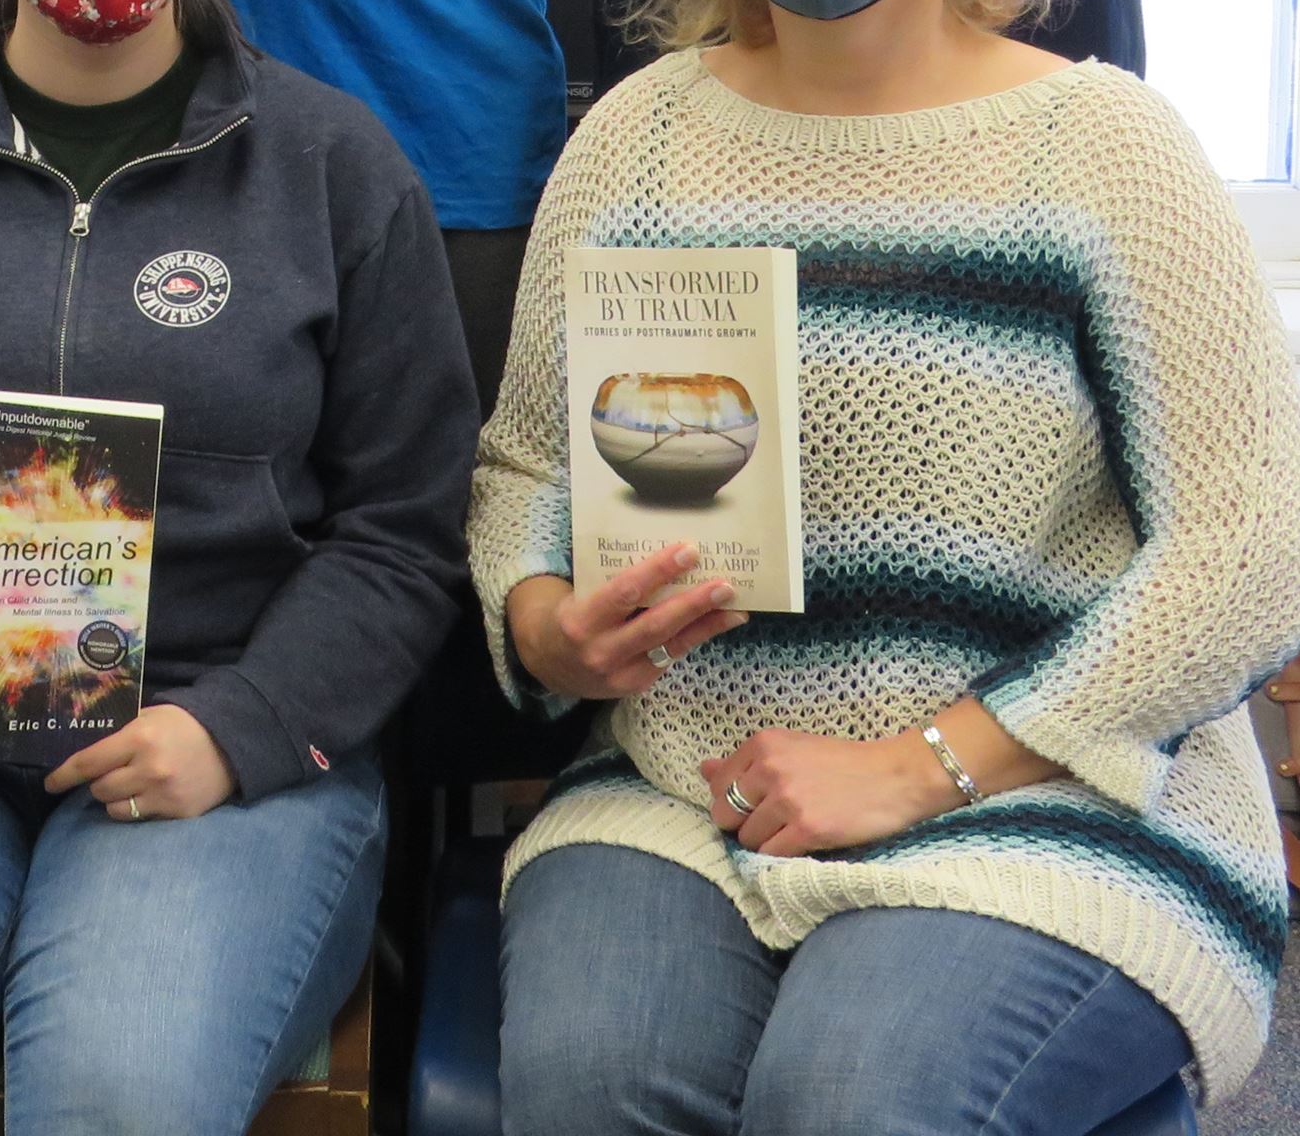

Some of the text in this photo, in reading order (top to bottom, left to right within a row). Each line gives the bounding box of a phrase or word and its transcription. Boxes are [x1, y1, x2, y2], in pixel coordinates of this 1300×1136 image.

[141, 253, 227, 287] SHIPPENSBURG
[579, 271, 759, 295] TRANSFORMED
[139, 290, 224, 324] UNIVERSITY
[600, 298, 737, 321] BY TRAUMA
[584, 327, 756, 338] STORIES OF POSTTRAUMATIC GROWTH
[597, 537, 639, 552] Richard
[716, 541, 743, 555] PhD
[746, 546, 761, 555] and
[600, 554, 623, 568] Bret
[723, 559, 760, 573] ABPP
[7, 595, 30, 605] Child
[32, 595, 59, 605] Abuse
[61, 595, 77, 605] and
[13, 607, 125, 616] Mental Illness to Salvation
[8, 717, 115, 731] Eric C. Arauz
